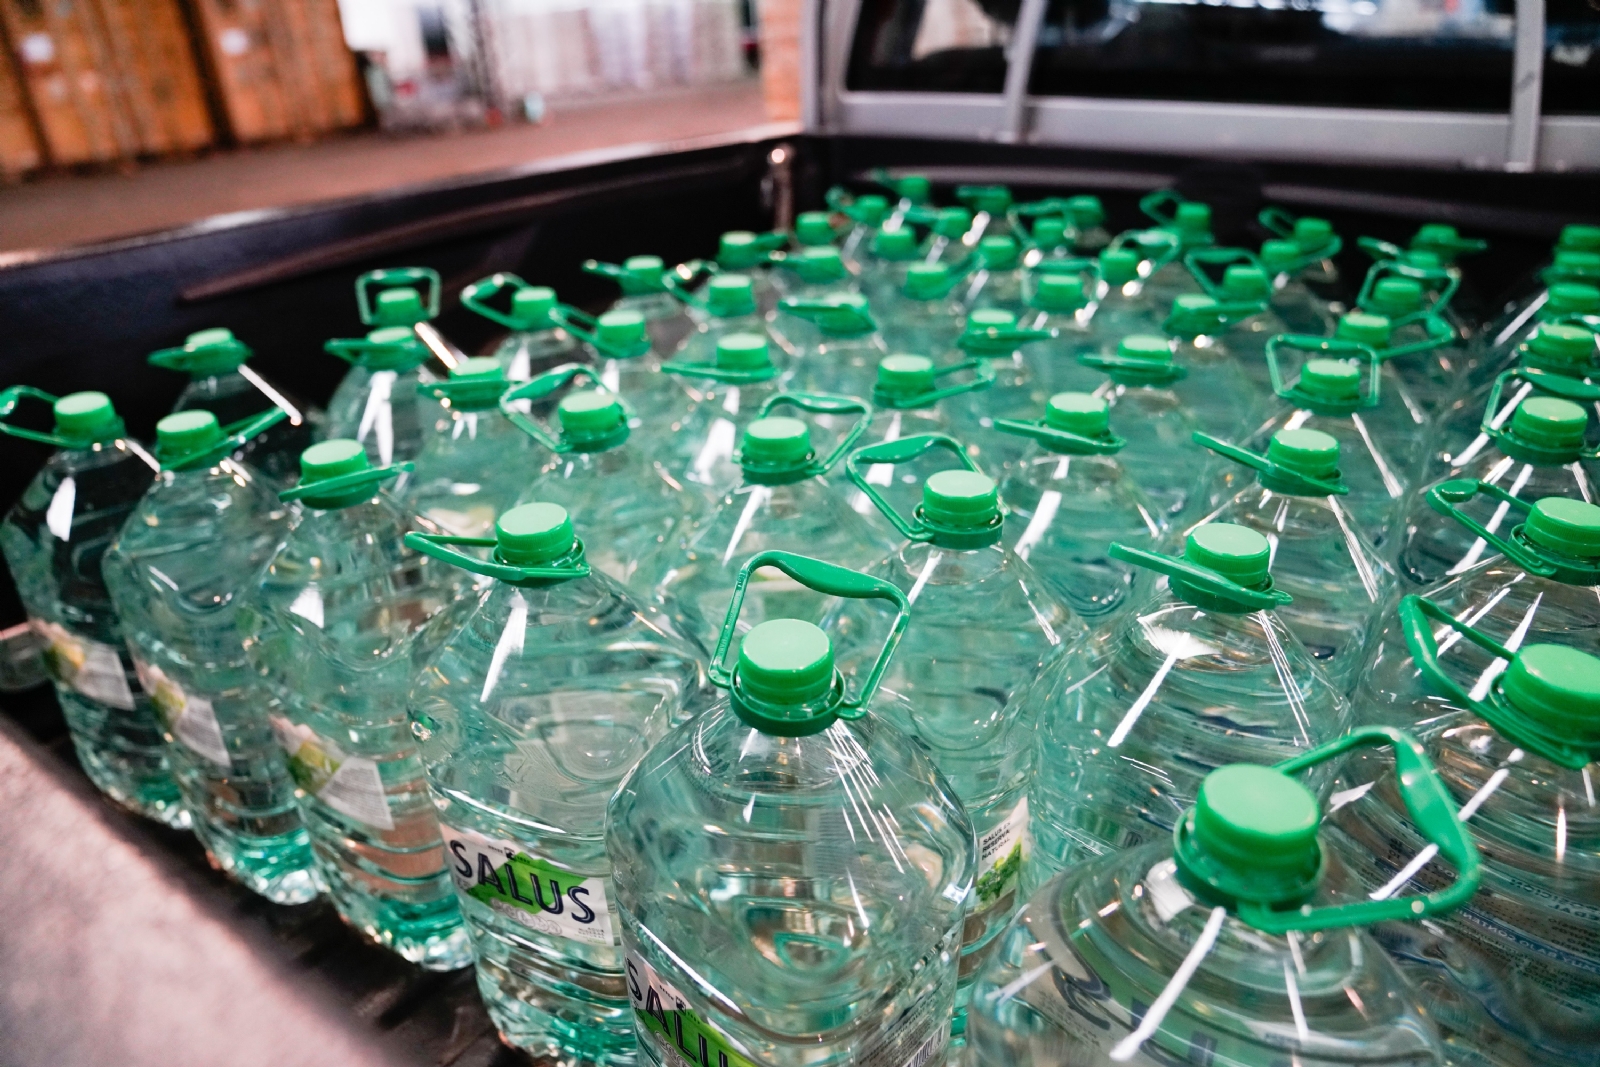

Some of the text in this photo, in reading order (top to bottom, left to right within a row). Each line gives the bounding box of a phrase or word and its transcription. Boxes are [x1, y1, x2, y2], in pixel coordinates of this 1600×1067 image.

[983, 827, 1002, 845] SALUS
[983, 829, 1010, 853] RESERVA
[449, 839, 596, 924] SALUS
